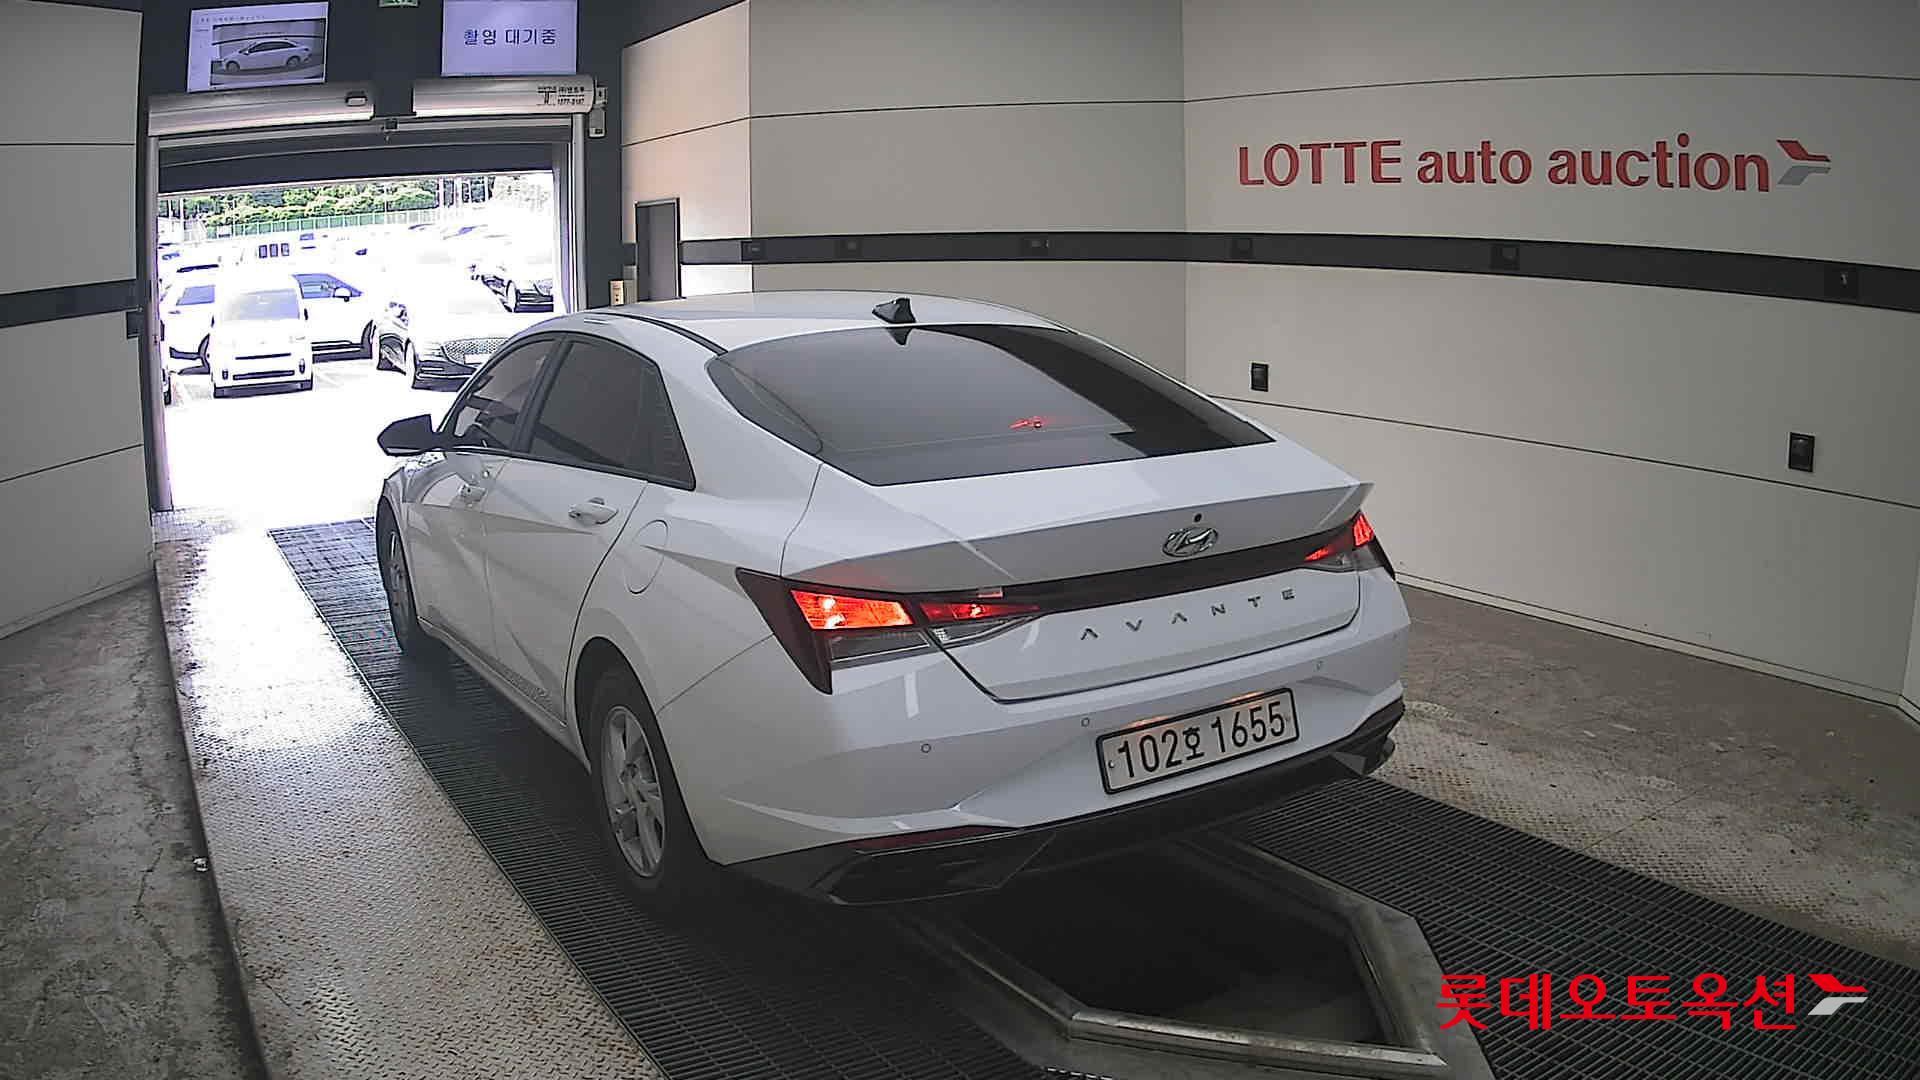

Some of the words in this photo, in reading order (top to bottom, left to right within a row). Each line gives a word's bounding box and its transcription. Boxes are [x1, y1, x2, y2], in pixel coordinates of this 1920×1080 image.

[464, 29, 497, 46] 촬영
[505, 29, 556, 45] 대기중
[1238, 140, 1402, 187] LOTTE
[1416, 140, 1533, 185] auto
[1547, 132, 1770, 193] auction
[1080, 588, 1296, 641] AVANTE
[1210, 700, 1286, 754] 1655
